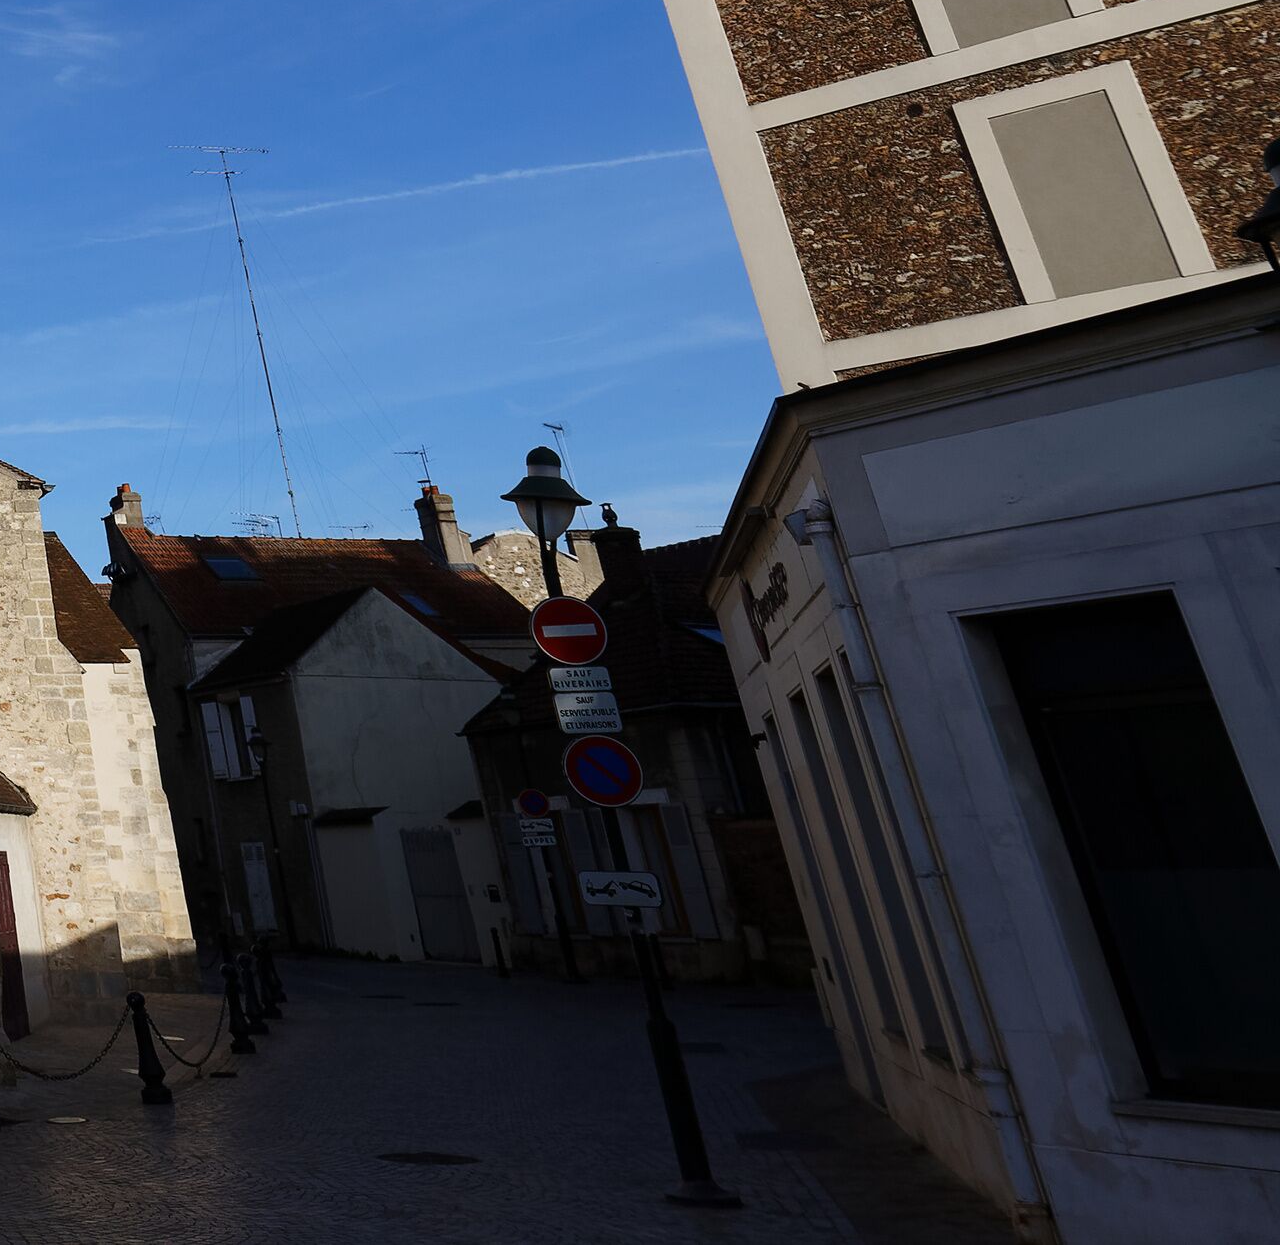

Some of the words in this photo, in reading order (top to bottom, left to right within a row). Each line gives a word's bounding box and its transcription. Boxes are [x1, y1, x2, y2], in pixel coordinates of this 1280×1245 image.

[554, 680, 609, 688] RIVERAINS
[560, 709, 591, 717] SERVICE
[591, 708, 616, 716] PUBLIC
[575, 721, 617, 729] LIVRAISONS
